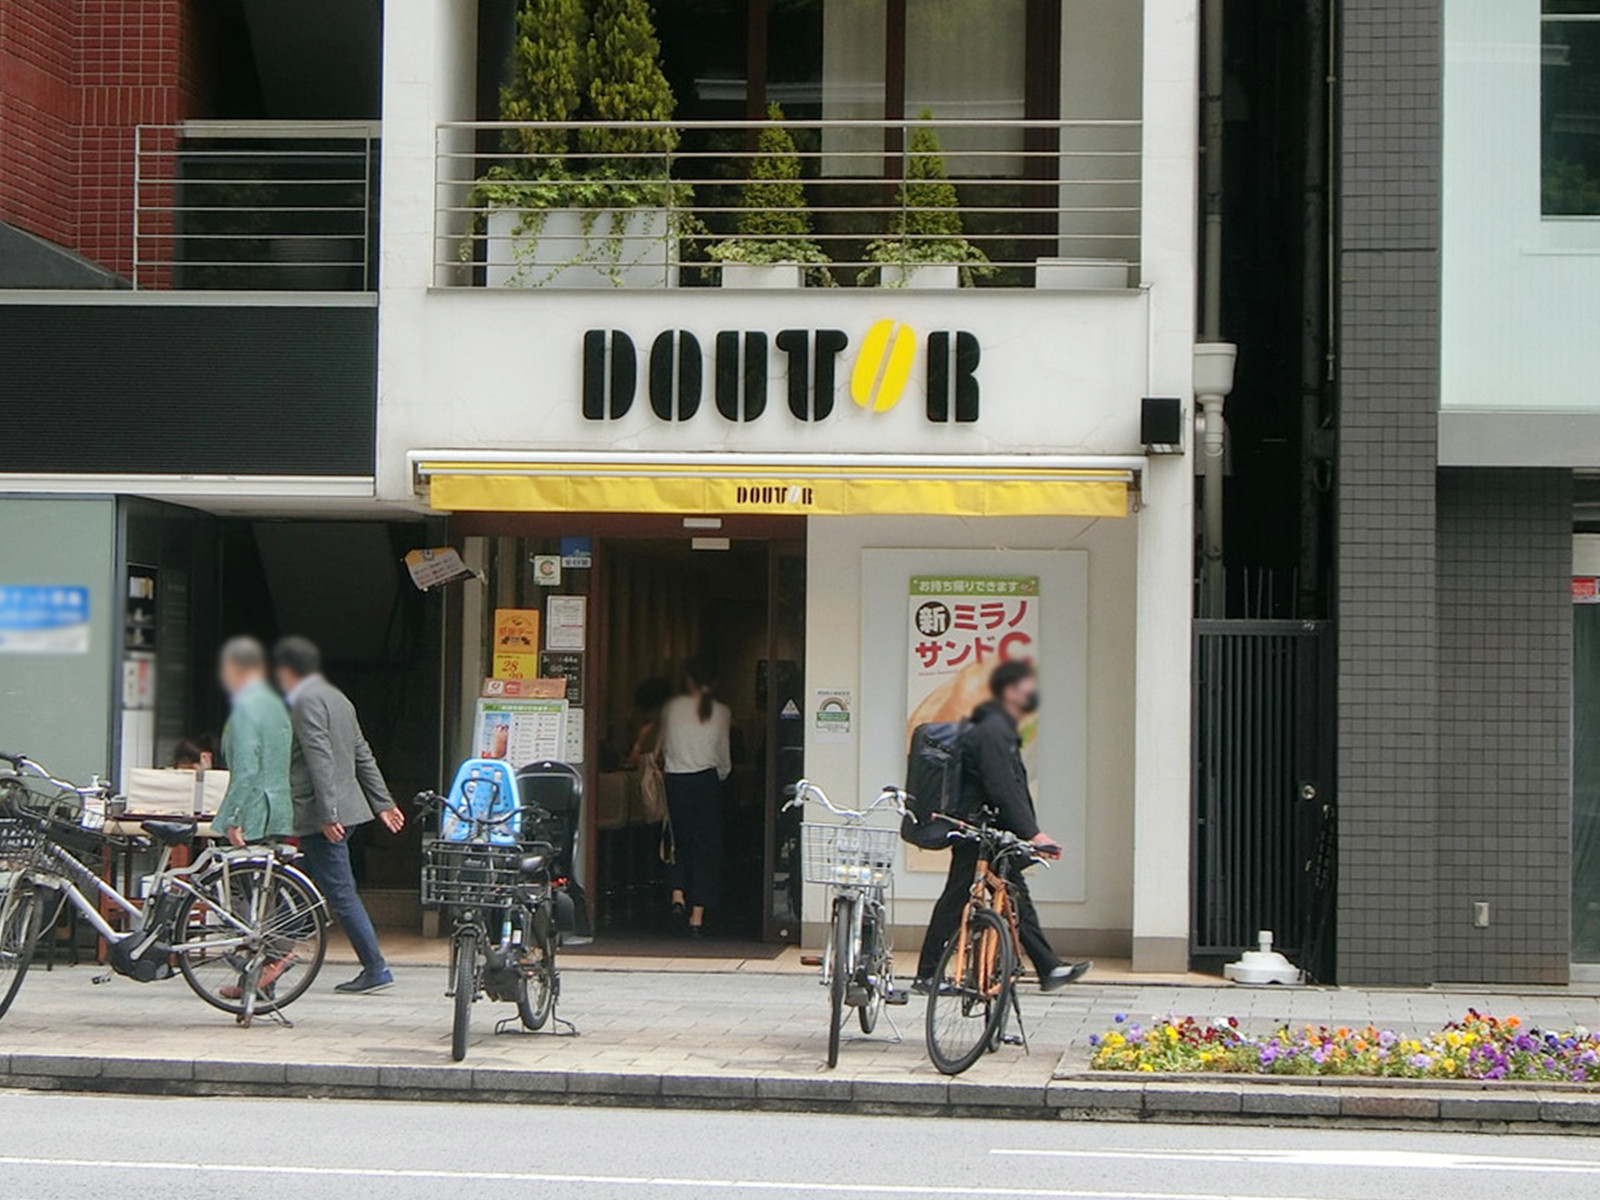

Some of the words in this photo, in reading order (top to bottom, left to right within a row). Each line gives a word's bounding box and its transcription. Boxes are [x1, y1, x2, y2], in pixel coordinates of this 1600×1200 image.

[582, 318, 981, 423] DOUTOR
[737, 485, 813, 505] DOUTOR
[919, 580, 1019, 593] お持ち帰りできます
